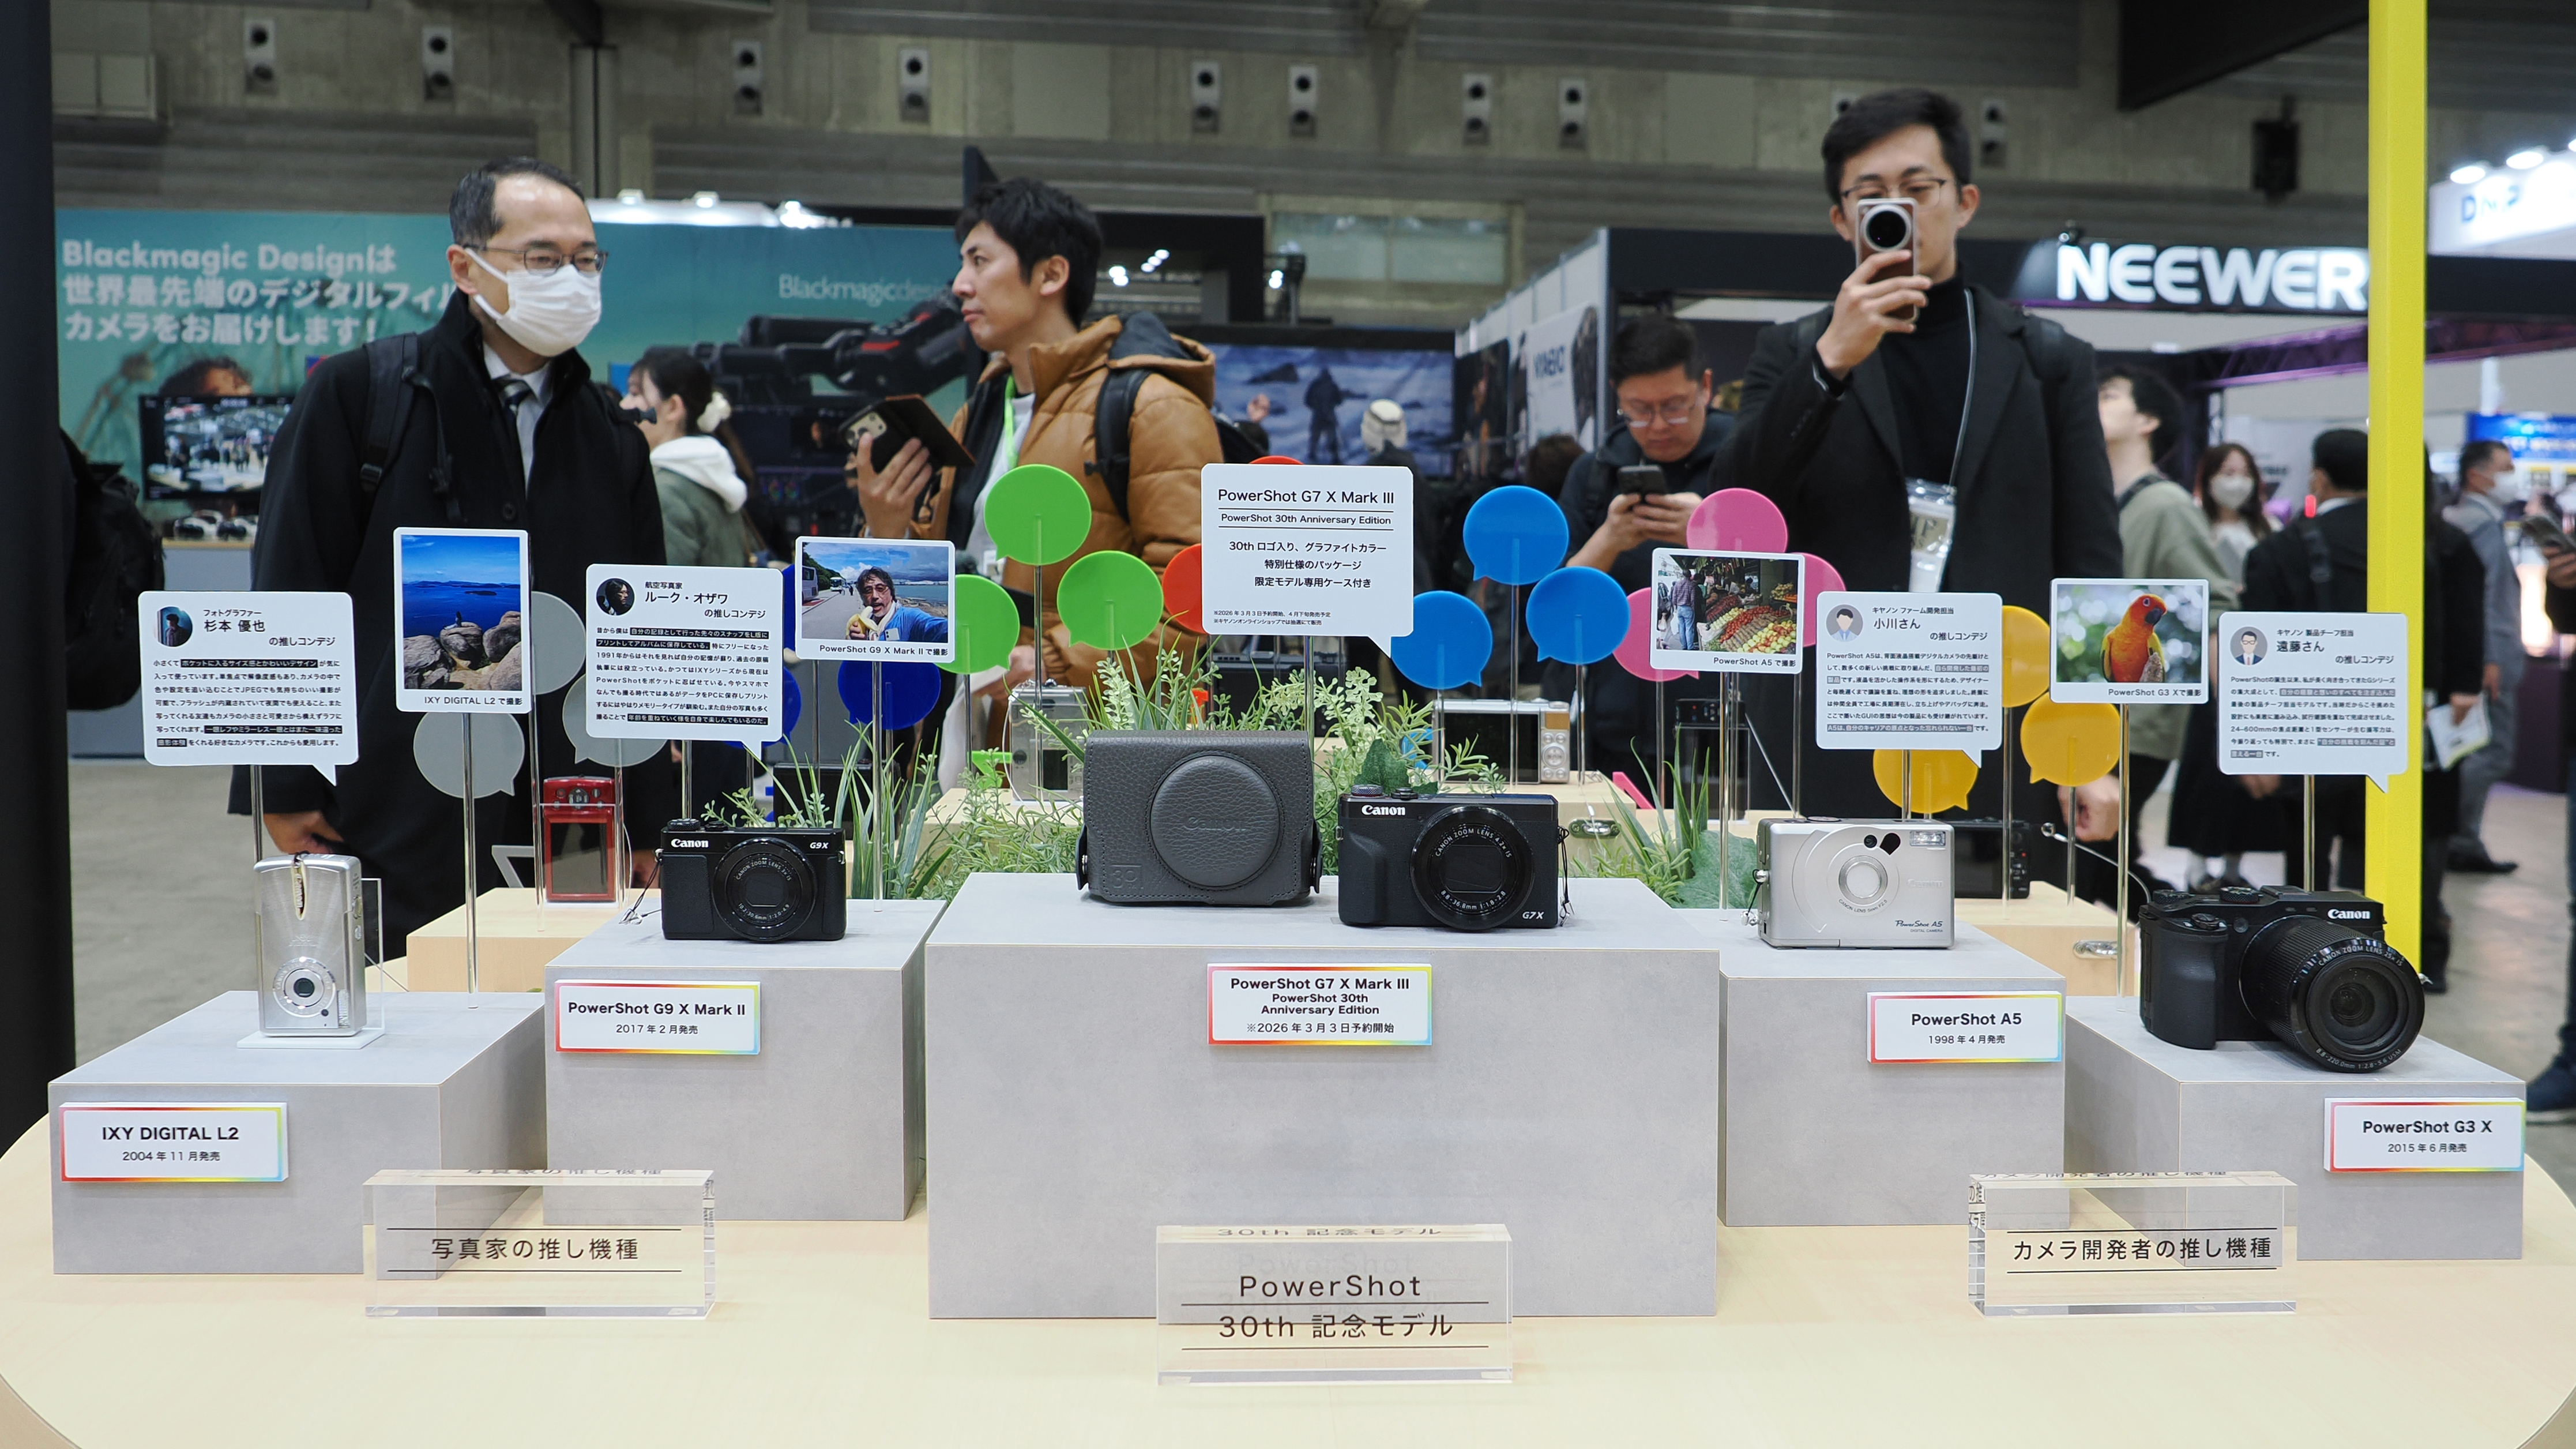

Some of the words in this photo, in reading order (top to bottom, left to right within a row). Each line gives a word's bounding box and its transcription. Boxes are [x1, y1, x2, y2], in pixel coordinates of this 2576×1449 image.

[63, 240, 247, 275] Blackmagic
[258, 243, 396, 279] Designは
[2057, 242, 2369, 310] NEEWER
[1219, 489, 1296, 502] PowerShot
[1302, 491, 1321, 502] G7
[1326, 491, 1336, 502] X
[1342, 491, 1378, 503] Mark
[1383, 493, 1393, 503] III
[1222, 514, 1272, 522] PowerShot
[1300, 516, 1356, 525] Anniversary
[1229, 542, 1254, 550] 30th
[1258, 542, 1386, 553] ロゴ入り、グラファイトカラー
[1265, 560, 1361, 569] 特別仕様のパッケージ
[1255, 577, 1371, 588] 限定モデル専用ケース付き
[645, 592, 727, 604] ルーク・オザワ
[705, 609, 765, 618] の推しコンデジ
[205, 620, 231, 632] 杉本
[238, 620, 265, 632] 優也
[1874, 618, 1920, 629] 小川さん
[269, 637, 335, 646] の推しコンデジ
[1930, 632, 1987, 640] の推しコンデジ
[2277, 641, 2324, 652] 遠藤さん
[1362, 805, 1405, 815] Canon
[671, 839, 708, 847] Canon
[1435, 836, 1453, 857] CANON
[1454, 828, 1474, 837] ZOOM
[1477, 828, 1494, 839] LENS
[736, 865, 750, 880] CANON
[769, 861, 781, 870] LENS
[1838, 899, 1853, 910] CANON
[2328, 909, 2370, 919] Canon
[2318, 950, 2341, 966] CANON
[1232, 978, 1310, 989] PowerShot
[1315, 978, 1334, 989] G7
[1340, 979, 1349, 989] X
[1356, 979, 1392, 989] Mark
[1398, 979, 1408, 989] III
[1273, 994, 1337, 1002] PowerShot
[1341, 994, 1368, 1002] 30th
[569, 1003, 649, 1013] PowerShot
[654, 1004, 673, 1014] G9
[679, 1004, 689, 1014] X
[695, 1004, 732, 1015] Mark
[738, 1005, 744, 1015] II
[1261, 1005, 1334, 1016] Anniversary
[1339, 1005, 1379, 1014] Edition
[1912, 1013, 1995, 1025] PowerShot
[2001, 1013, 2021, 1024] A5
[2364, 1121, 2449, 1133] PowerShot
[2455, 1121, 2475, 1132] G3
[2481, 1121, 2492, 1132] X
[103, 1127, 133, 1140] IXY
[140, 1127, 212, 1140] DIGITAL
[218, 1127, 238, 1139] L2
[432, 1238, 637, 1259] 写真家の推し機種
[2014, 1237, 2270, 1260] カメラ開発者の推し機種
[1241, 1275, 1420, 1297] PowerShot
[1219, 1316, 1293, 1337] 30th
[1313, 1312, 1453, 1338] 記念モデル
